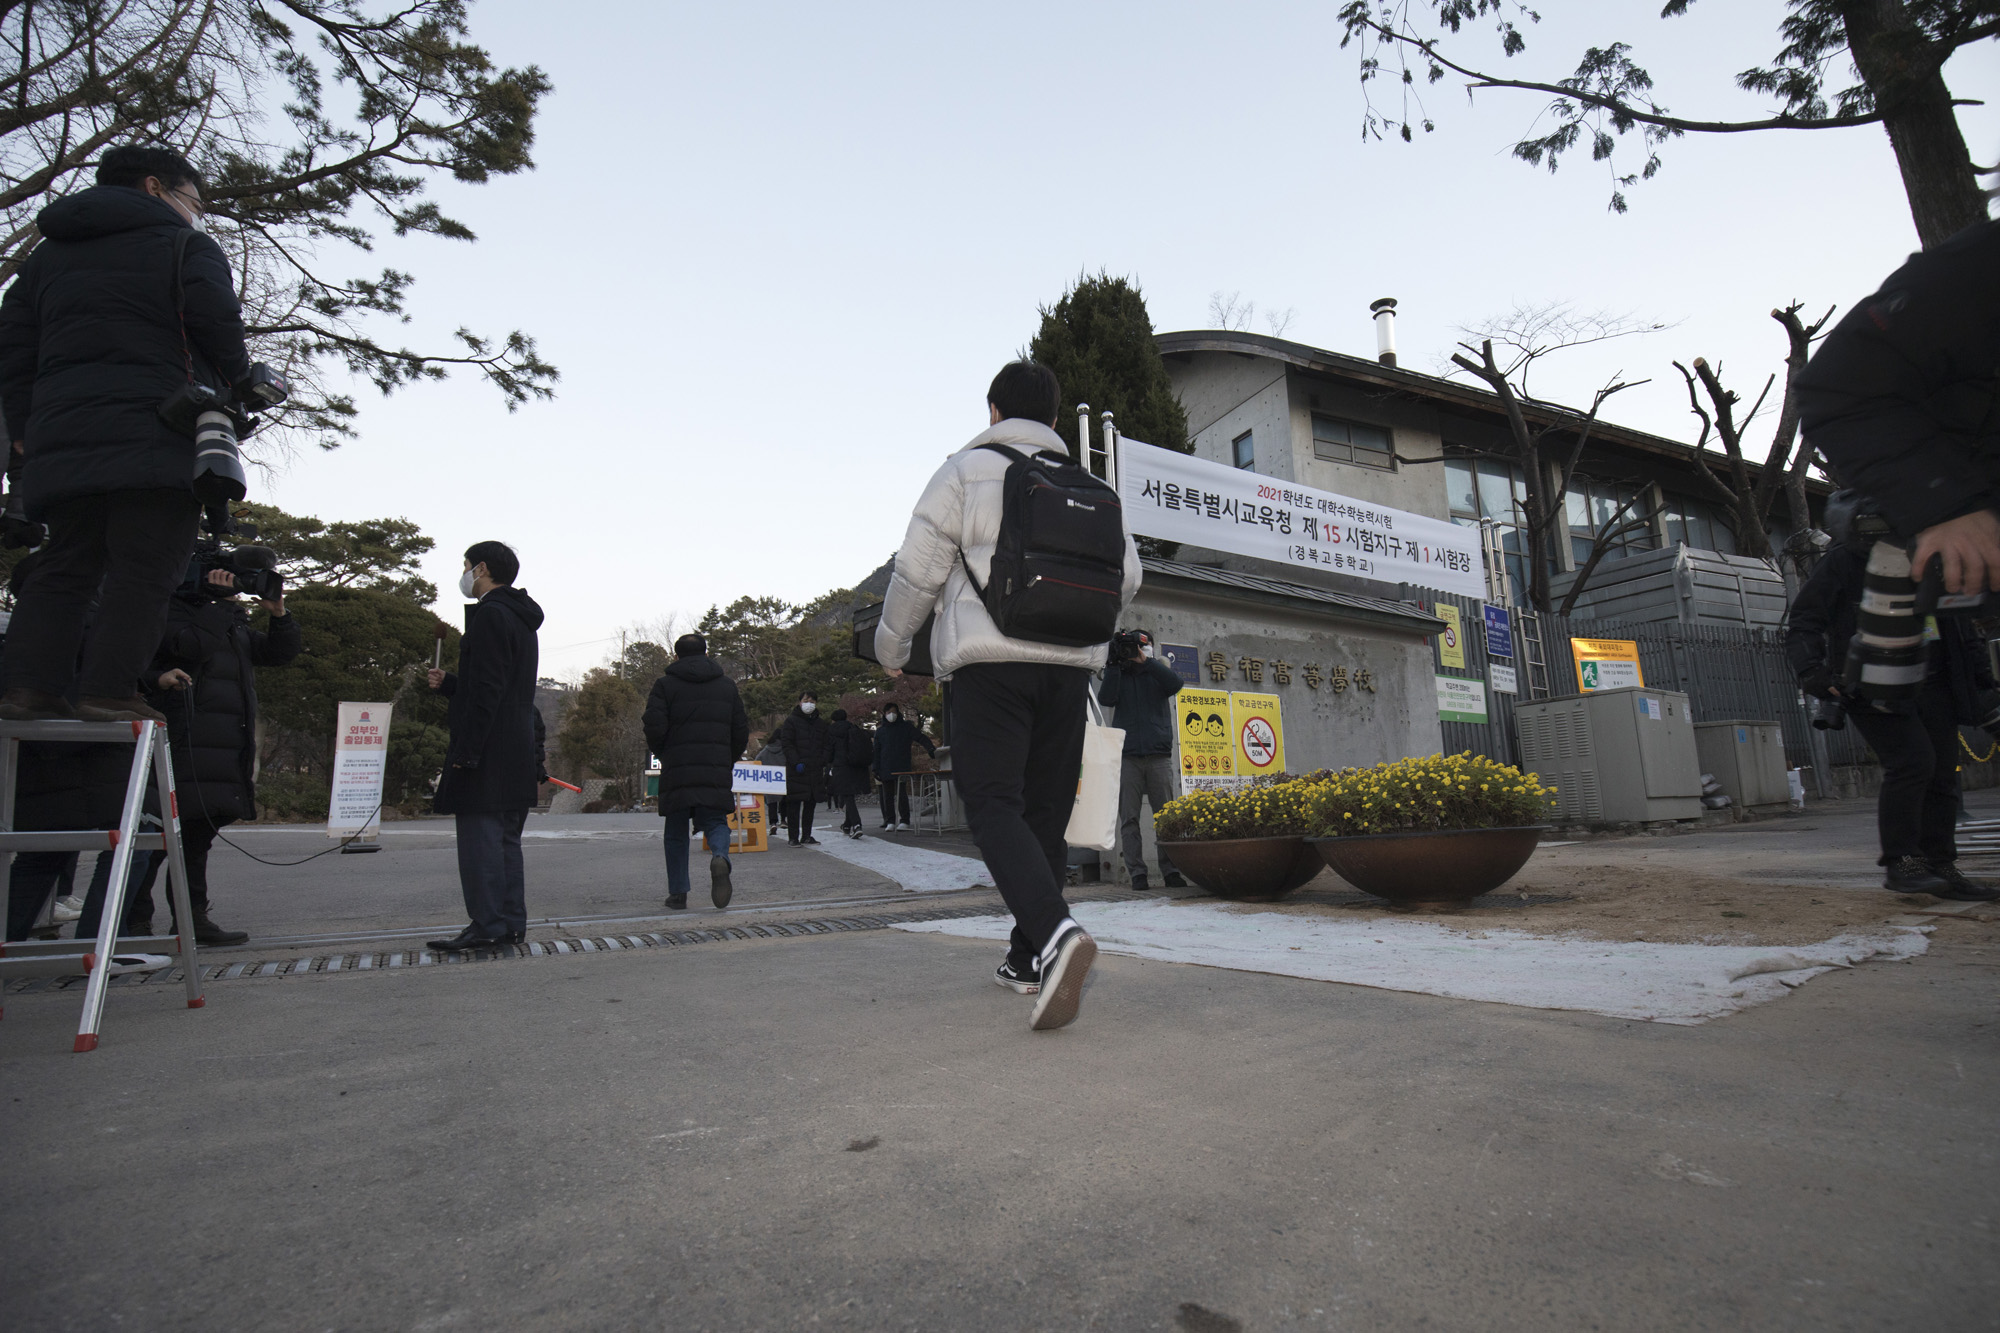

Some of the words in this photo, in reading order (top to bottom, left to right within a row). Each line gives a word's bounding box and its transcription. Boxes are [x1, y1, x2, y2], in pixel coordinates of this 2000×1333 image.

[1257, 484, 1315, 510] 2021학년도
[1316, 497, 1393, 530] 대학수학능력시험
[1141, 479, 1293, 535] 서울특별시교육청
[1302, 516, 1318, 542] 제
[1323, 523, 1341, 544] 15
[1346, 527, 1403, 559] 시험지구
[1405, 540, 1419, 563] 제
[1423, 546, 1430, 563] 1
[1434, 547, 1471, 573] 시험장
[1180, 695, 1227, 706] 교육환경보호구역
[1238, 699, 1274, 710] 학교금연구역
[349, 725, 379, 735] 외부인
[344, 736, 383, 746] 출입통제
[733, 769, 786, 783] 꺼내세요
